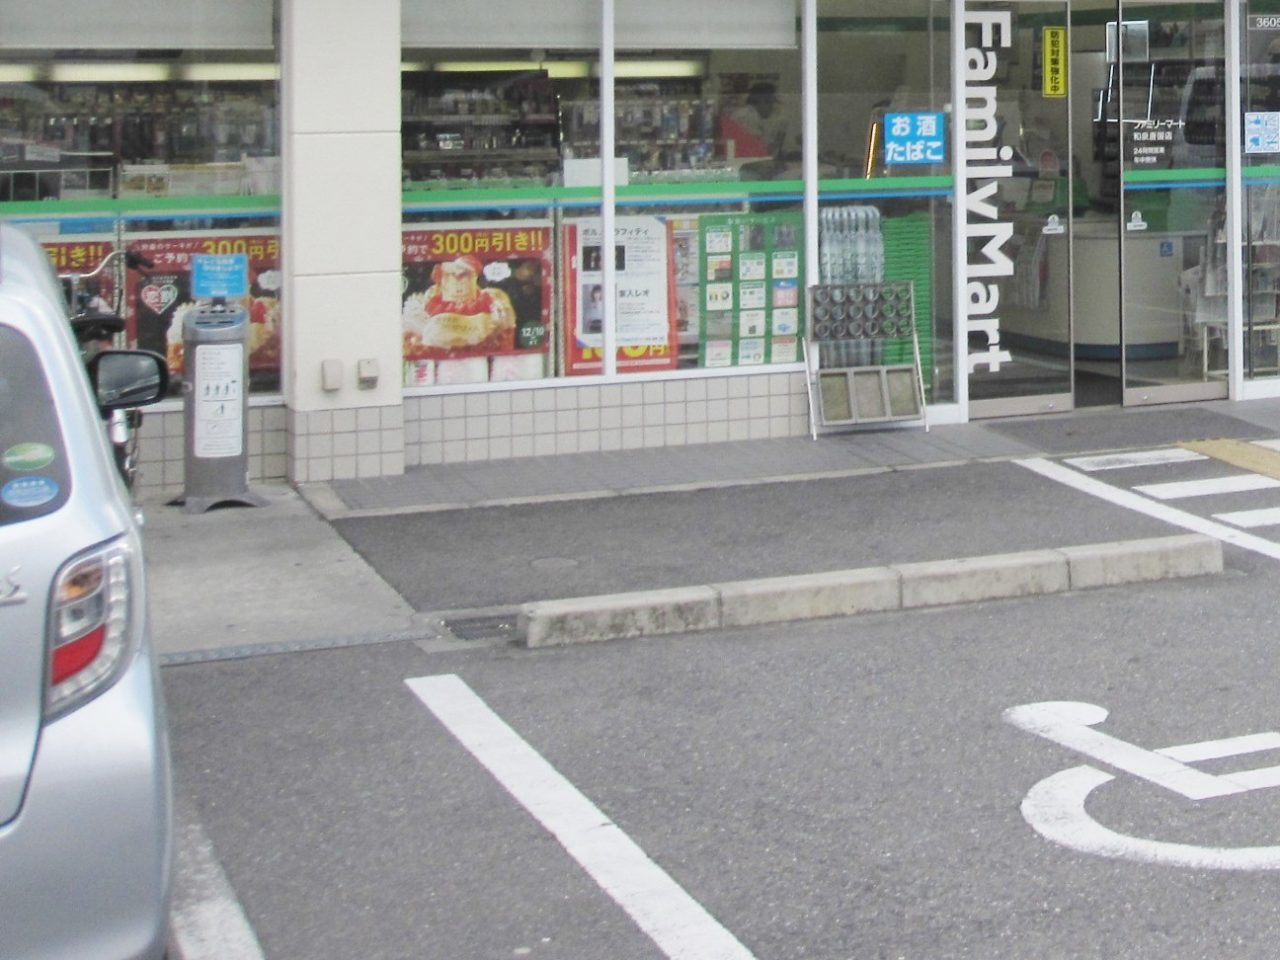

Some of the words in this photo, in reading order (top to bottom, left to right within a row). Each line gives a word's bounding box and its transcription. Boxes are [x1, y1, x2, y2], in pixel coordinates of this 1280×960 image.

[891, 115, 937, 137] お酒
[1133, 119, 1186, 129] ファミリーマート
[886, 140, 944, 161] たばこ
[582, 227, 650, 237] ポルラフィティ
